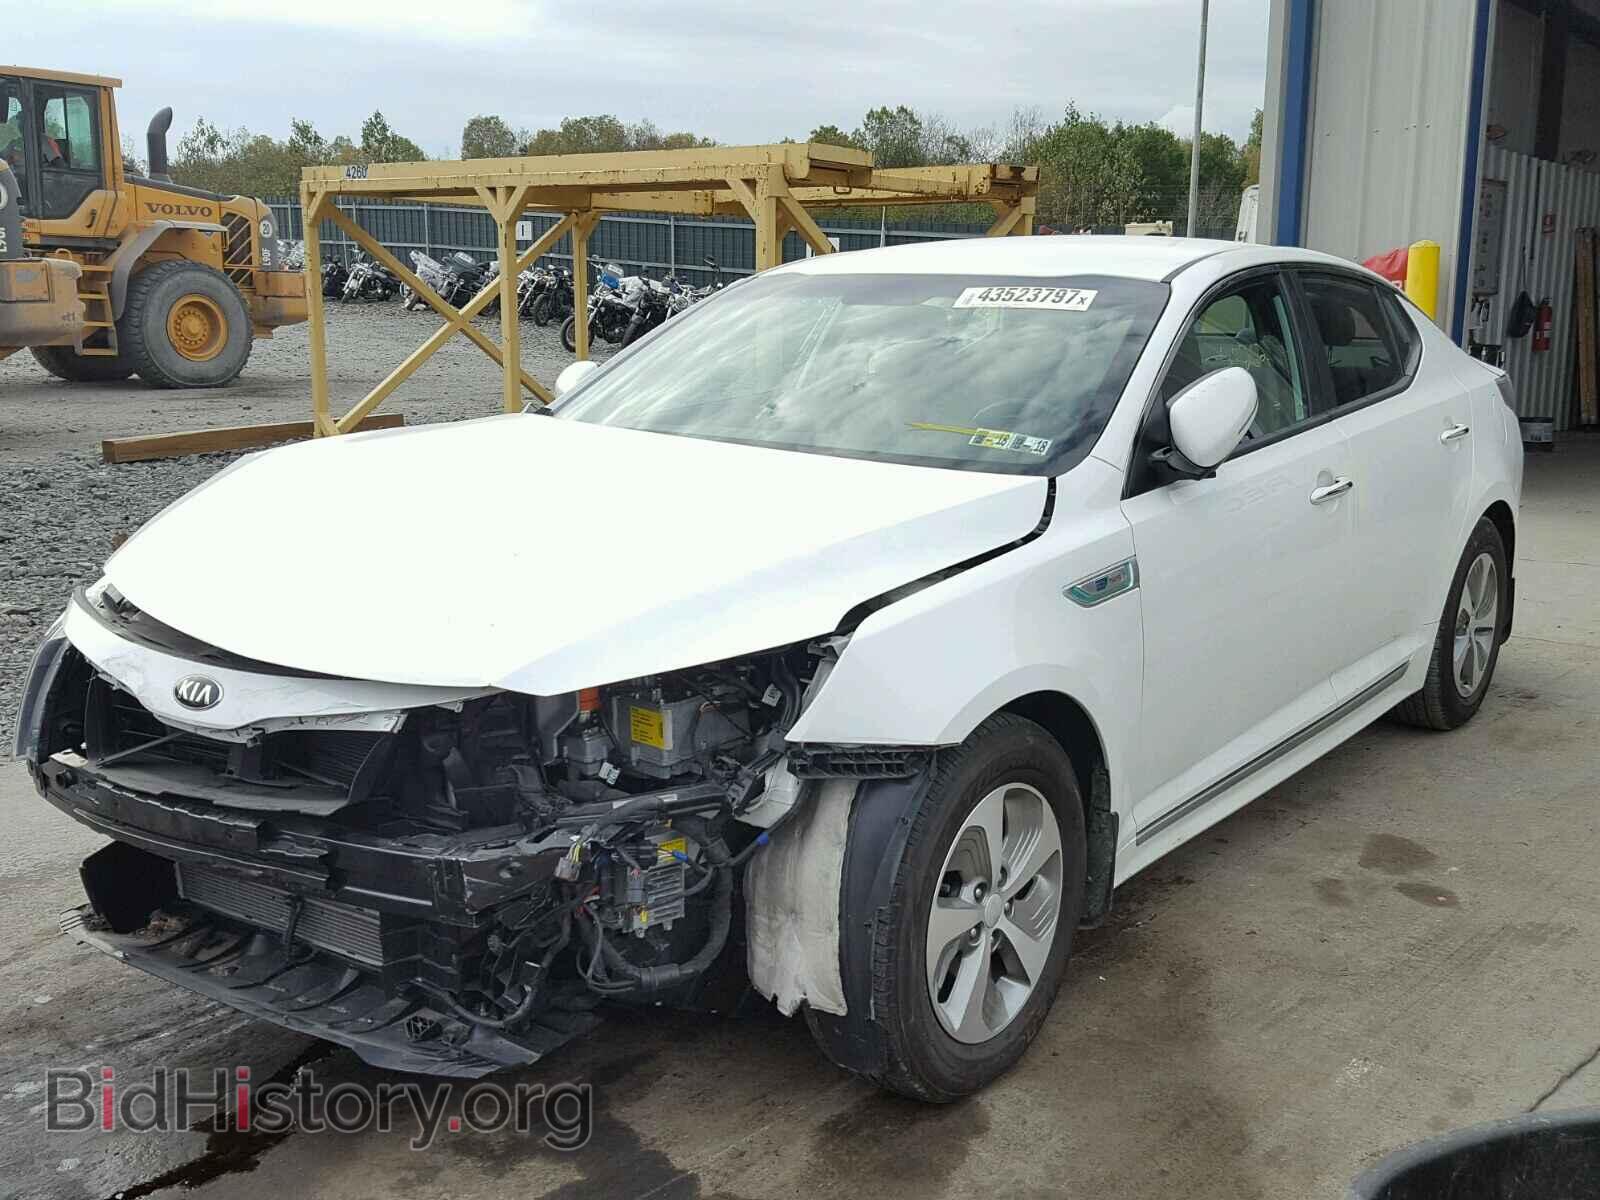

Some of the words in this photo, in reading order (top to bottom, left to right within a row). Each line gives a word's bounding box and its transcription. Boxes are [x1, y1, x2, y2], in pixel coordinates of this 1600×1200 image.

[346, 165, 368, 179] 4260
[144, 201, 213, 217] VOLVO
[177, 679, 212, 705] KIA
